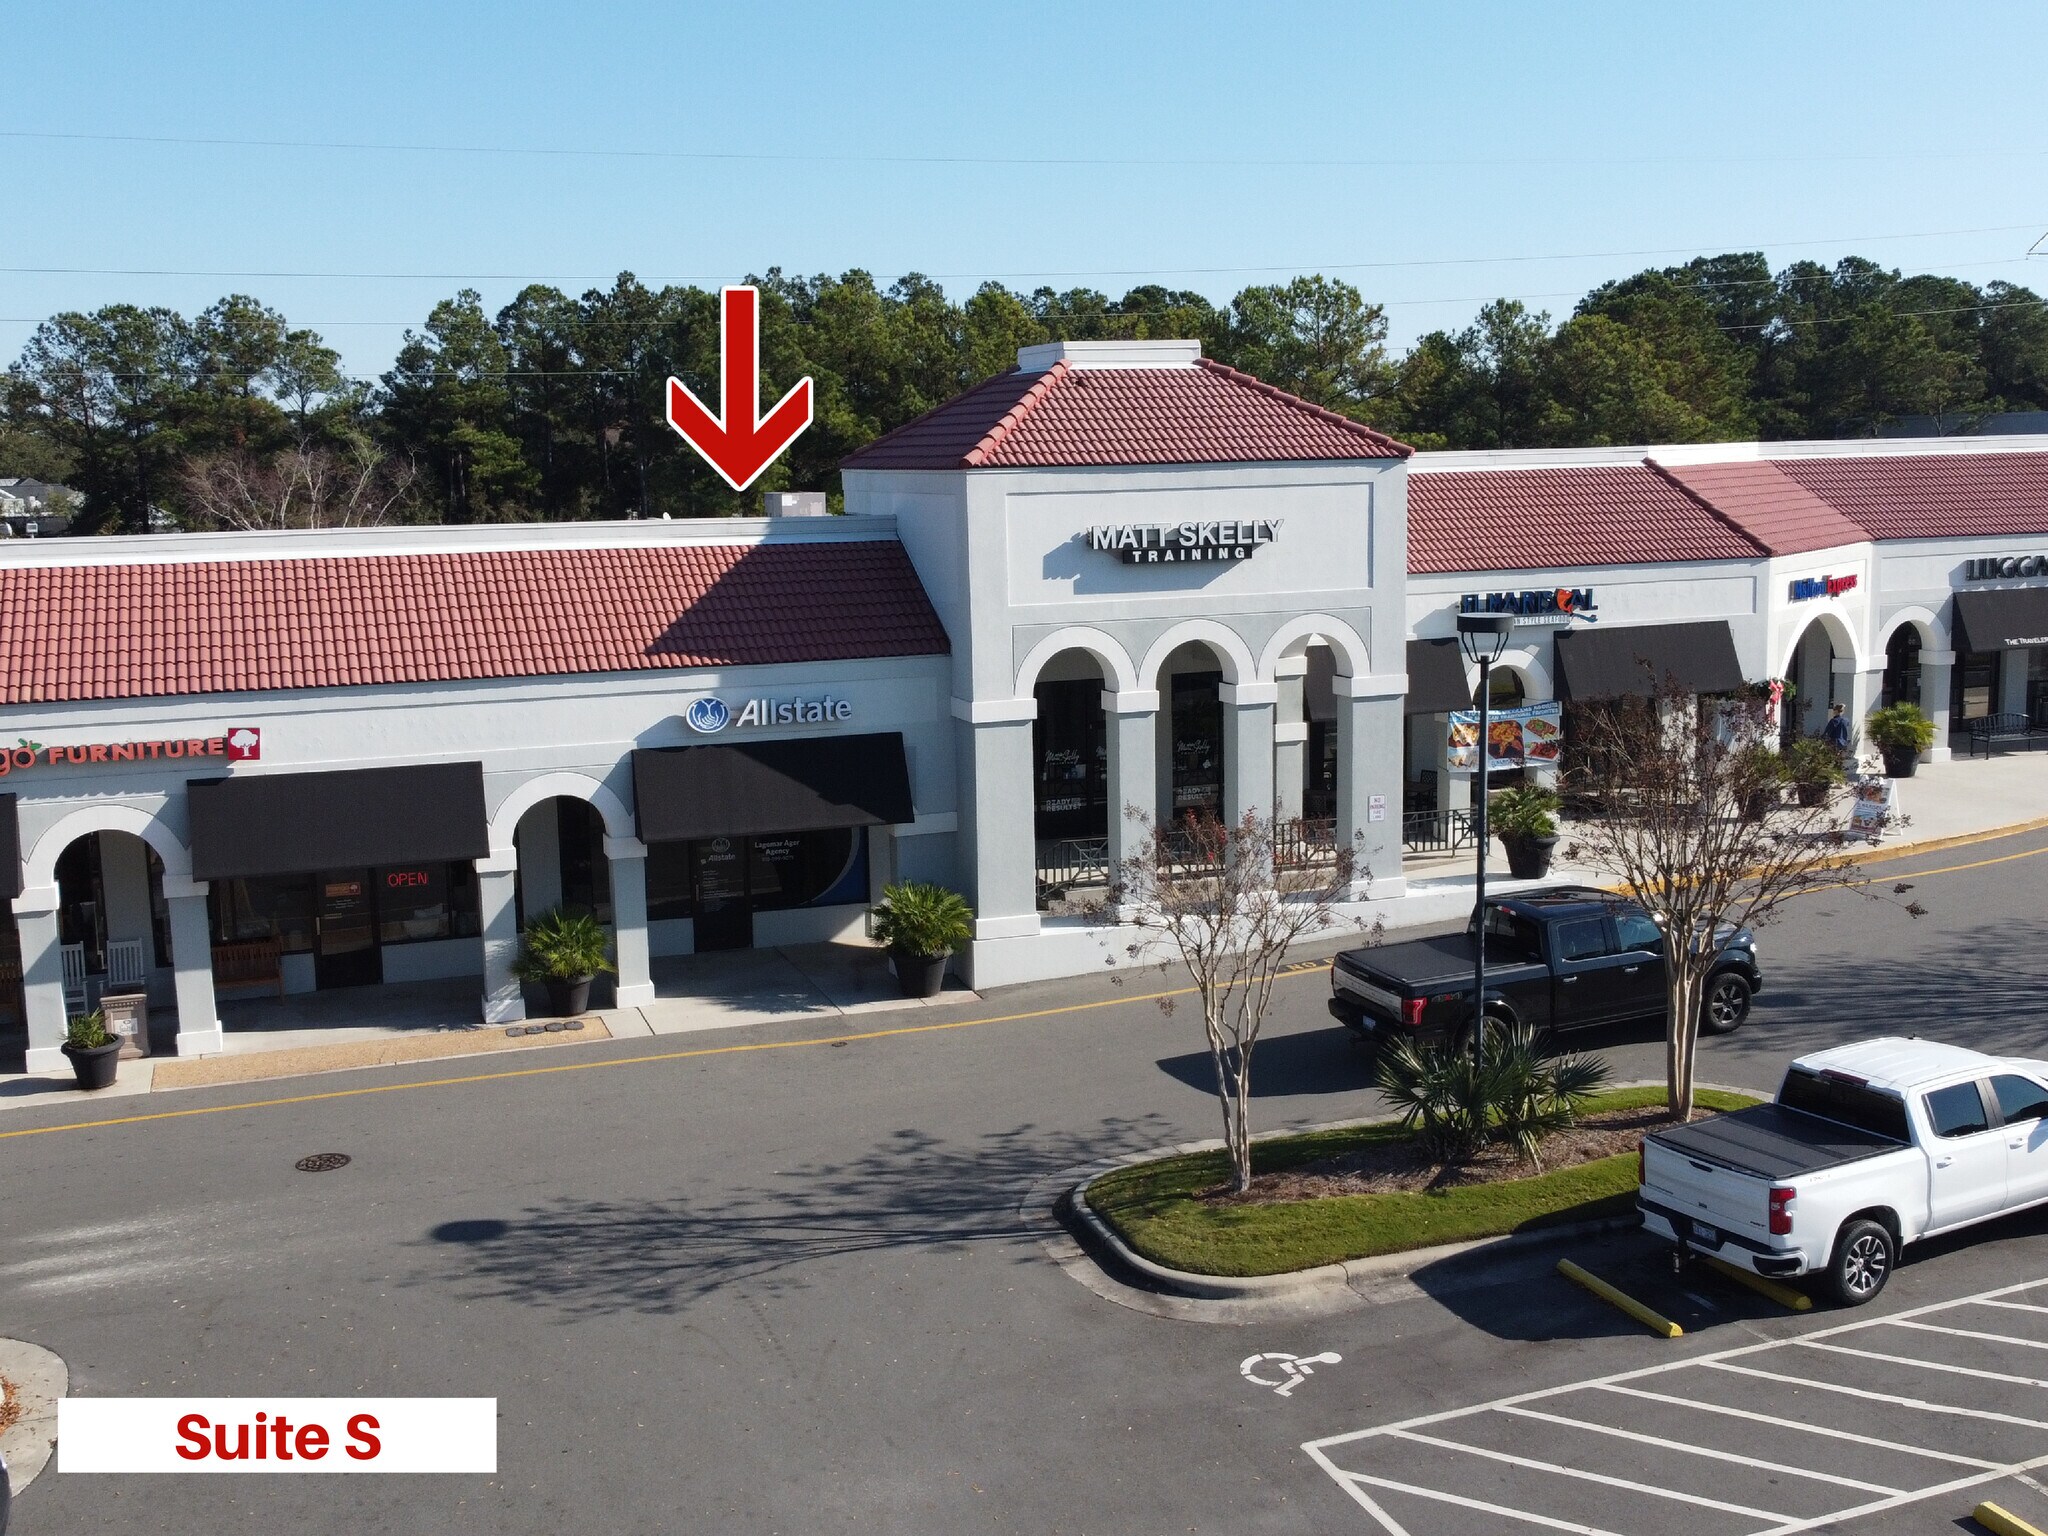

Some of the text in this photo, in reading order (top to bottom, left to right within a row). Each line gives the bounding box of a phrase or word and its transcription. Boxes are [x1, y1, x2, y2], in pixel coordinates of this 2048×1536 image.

[1092, 518, 1284, 549] MATT SKELLY
[1132, 547, 1245, 563] TRAINING
[2004, 638, 2020, 646] THE
[735, 695, 852, 727] Allstate
[48, 737, 224, 765] FURNITURE
[708, 854, 736, 862] Allstate
[765, 848, 790, 856] Agency
[387, 872, 428, 887] OPEN
